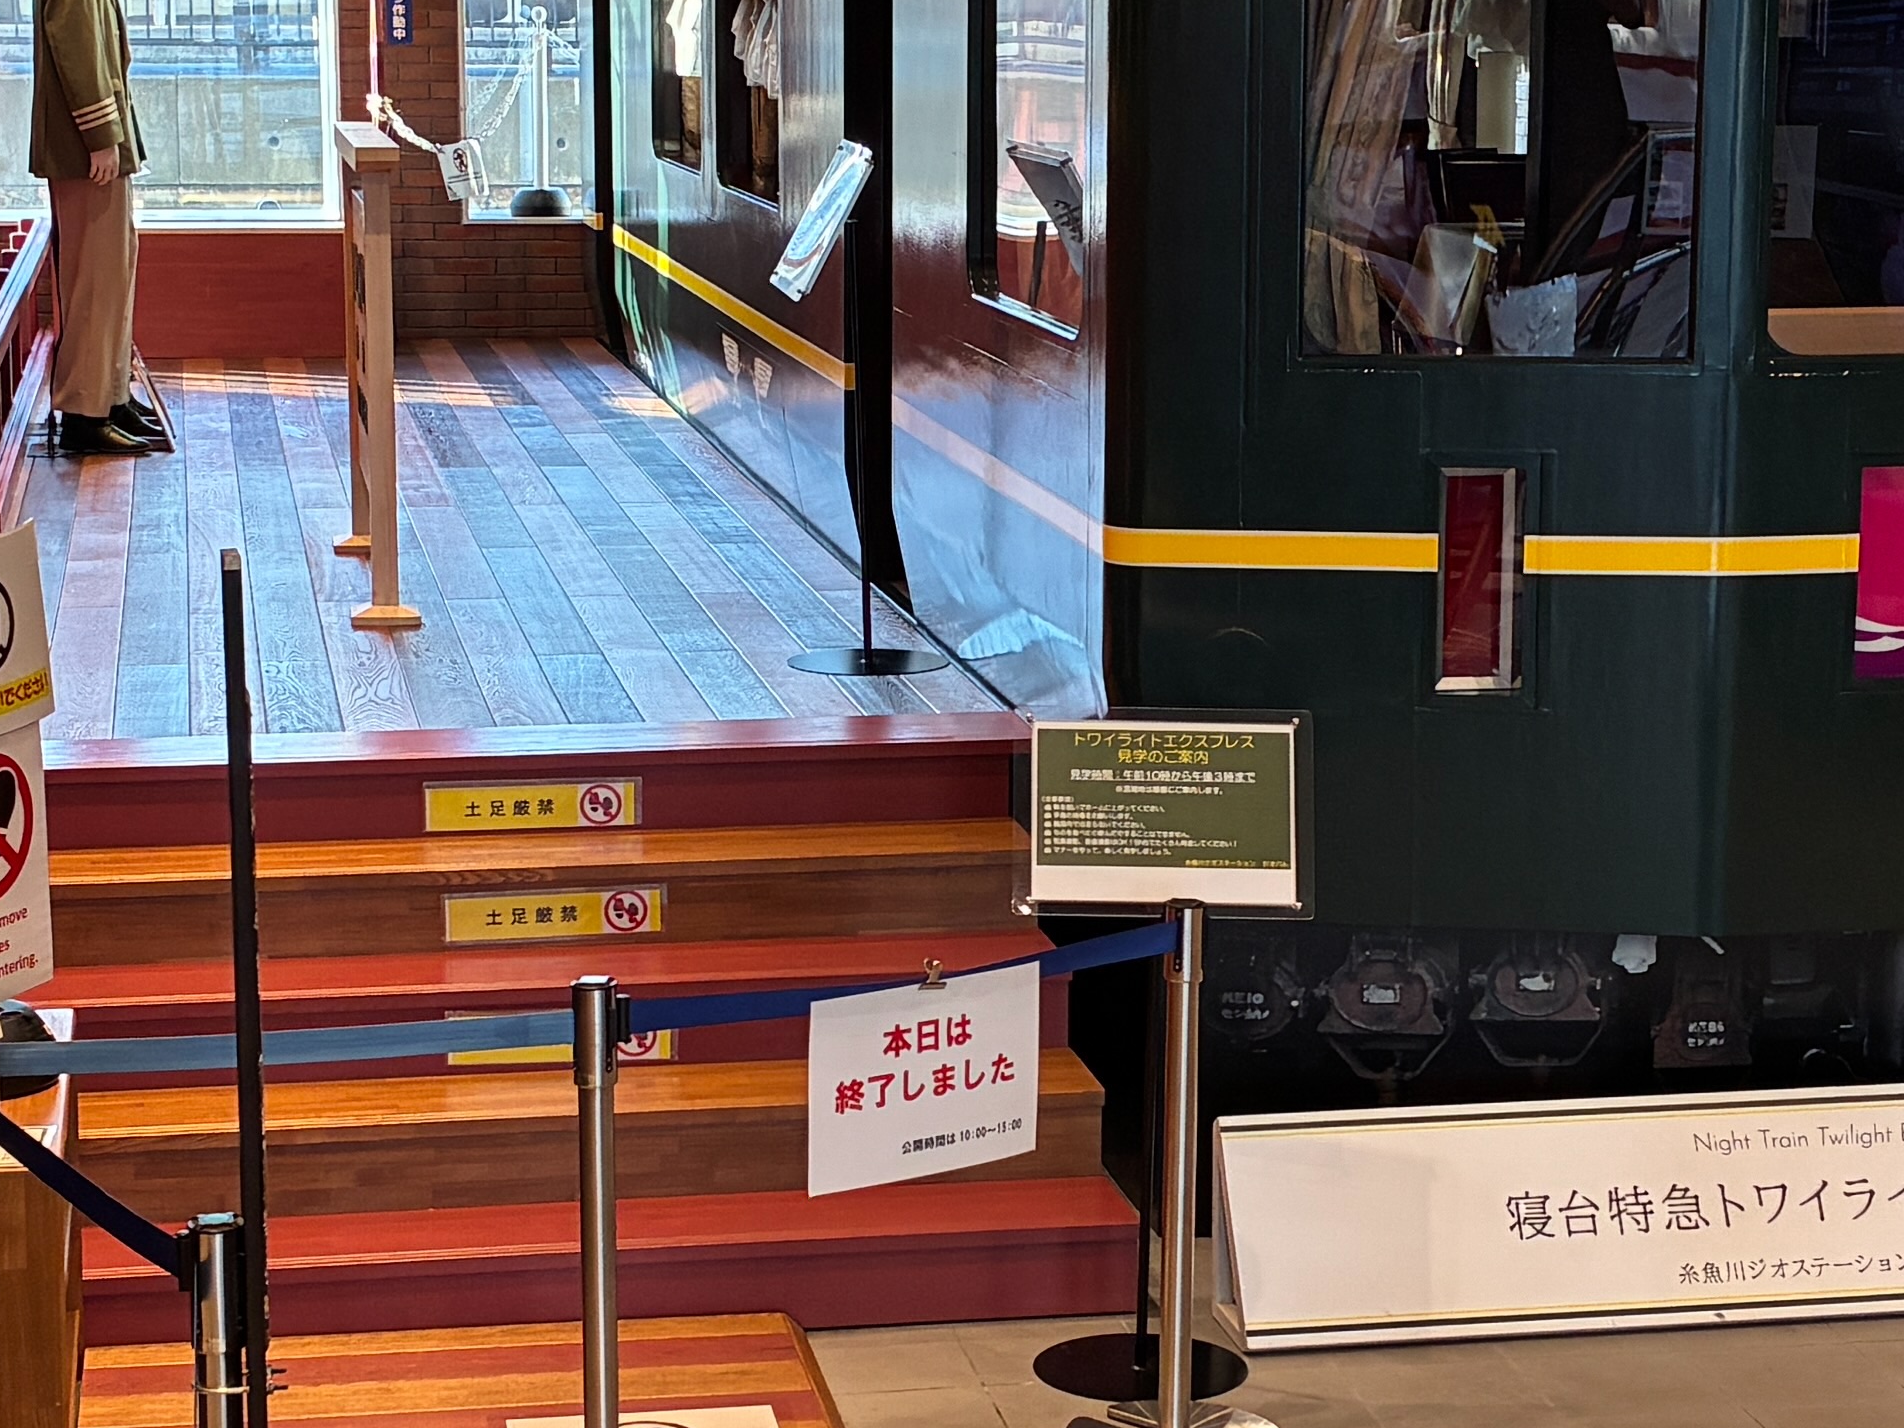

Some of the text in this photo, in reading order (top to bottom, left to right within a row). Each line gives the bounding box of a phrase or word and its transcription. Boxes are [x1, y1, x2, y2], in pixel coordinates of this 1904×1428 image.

[1072, 732, 1255, 750] トワイライトエクスプレス
[1117, 749, 1209, 765] 見学のご案内
[463, 797, 556, 818] 土足厳禁
[485, 905, 578, 926] 土足厳禁
[882, 1013, 973, 1058] 本日は
[834, 1052, 1016, 1115] 終了しました
[901, 1132, 956, 1155] 公開時間は
[1693, 1128, 1752, 1158] Night
[1759, 1125, 1810, 1149] Train
[1818, 1121, 1894, 1152] Twilight
